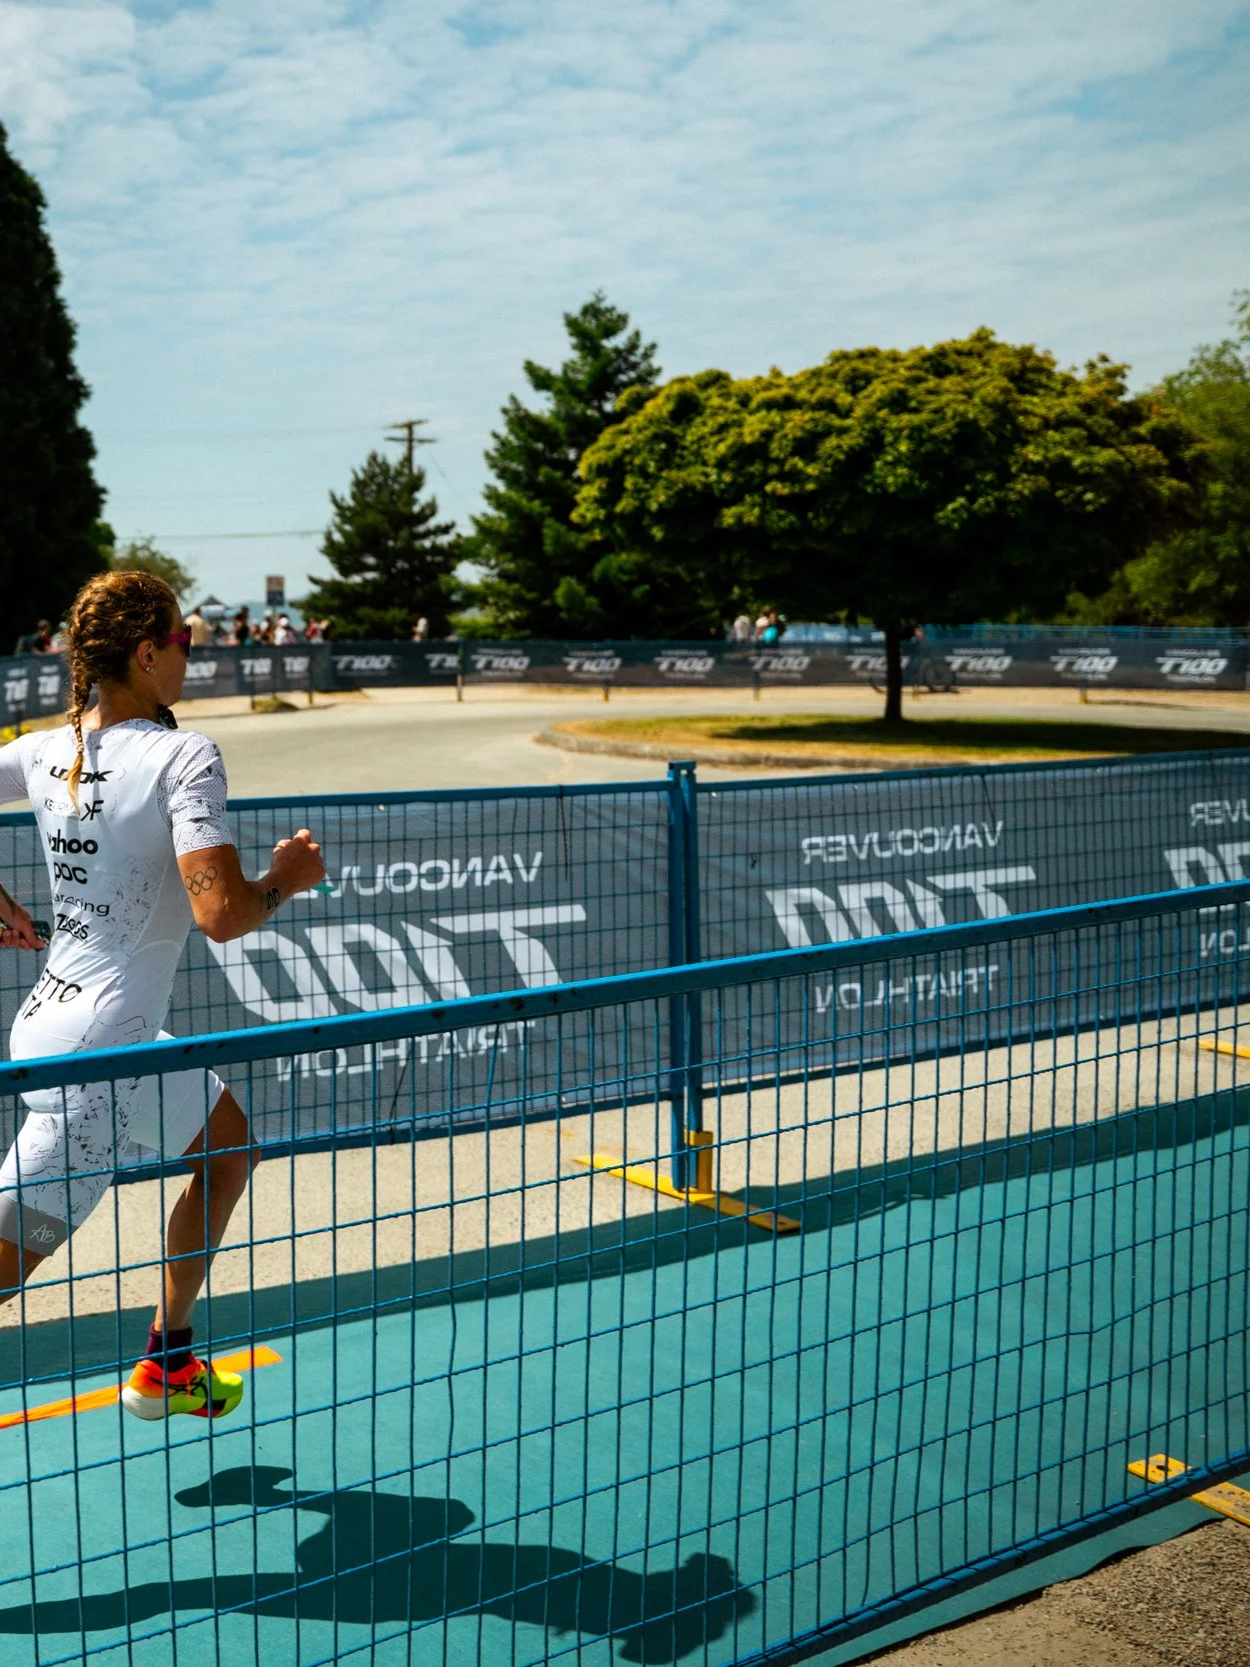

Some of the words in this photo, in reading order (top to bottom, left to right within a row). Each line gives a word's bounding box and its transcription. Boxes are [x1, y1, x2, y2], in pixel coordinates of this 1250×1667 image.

[470, 654, 529, 670] T100
[654, 656, 715, 672] T100
[748, 655, 810, 671] T100
[944, 655, 1013, 671] T100
[1050, 655, 1118, 672] T100
[1155, 656, 1228, 675] T100
